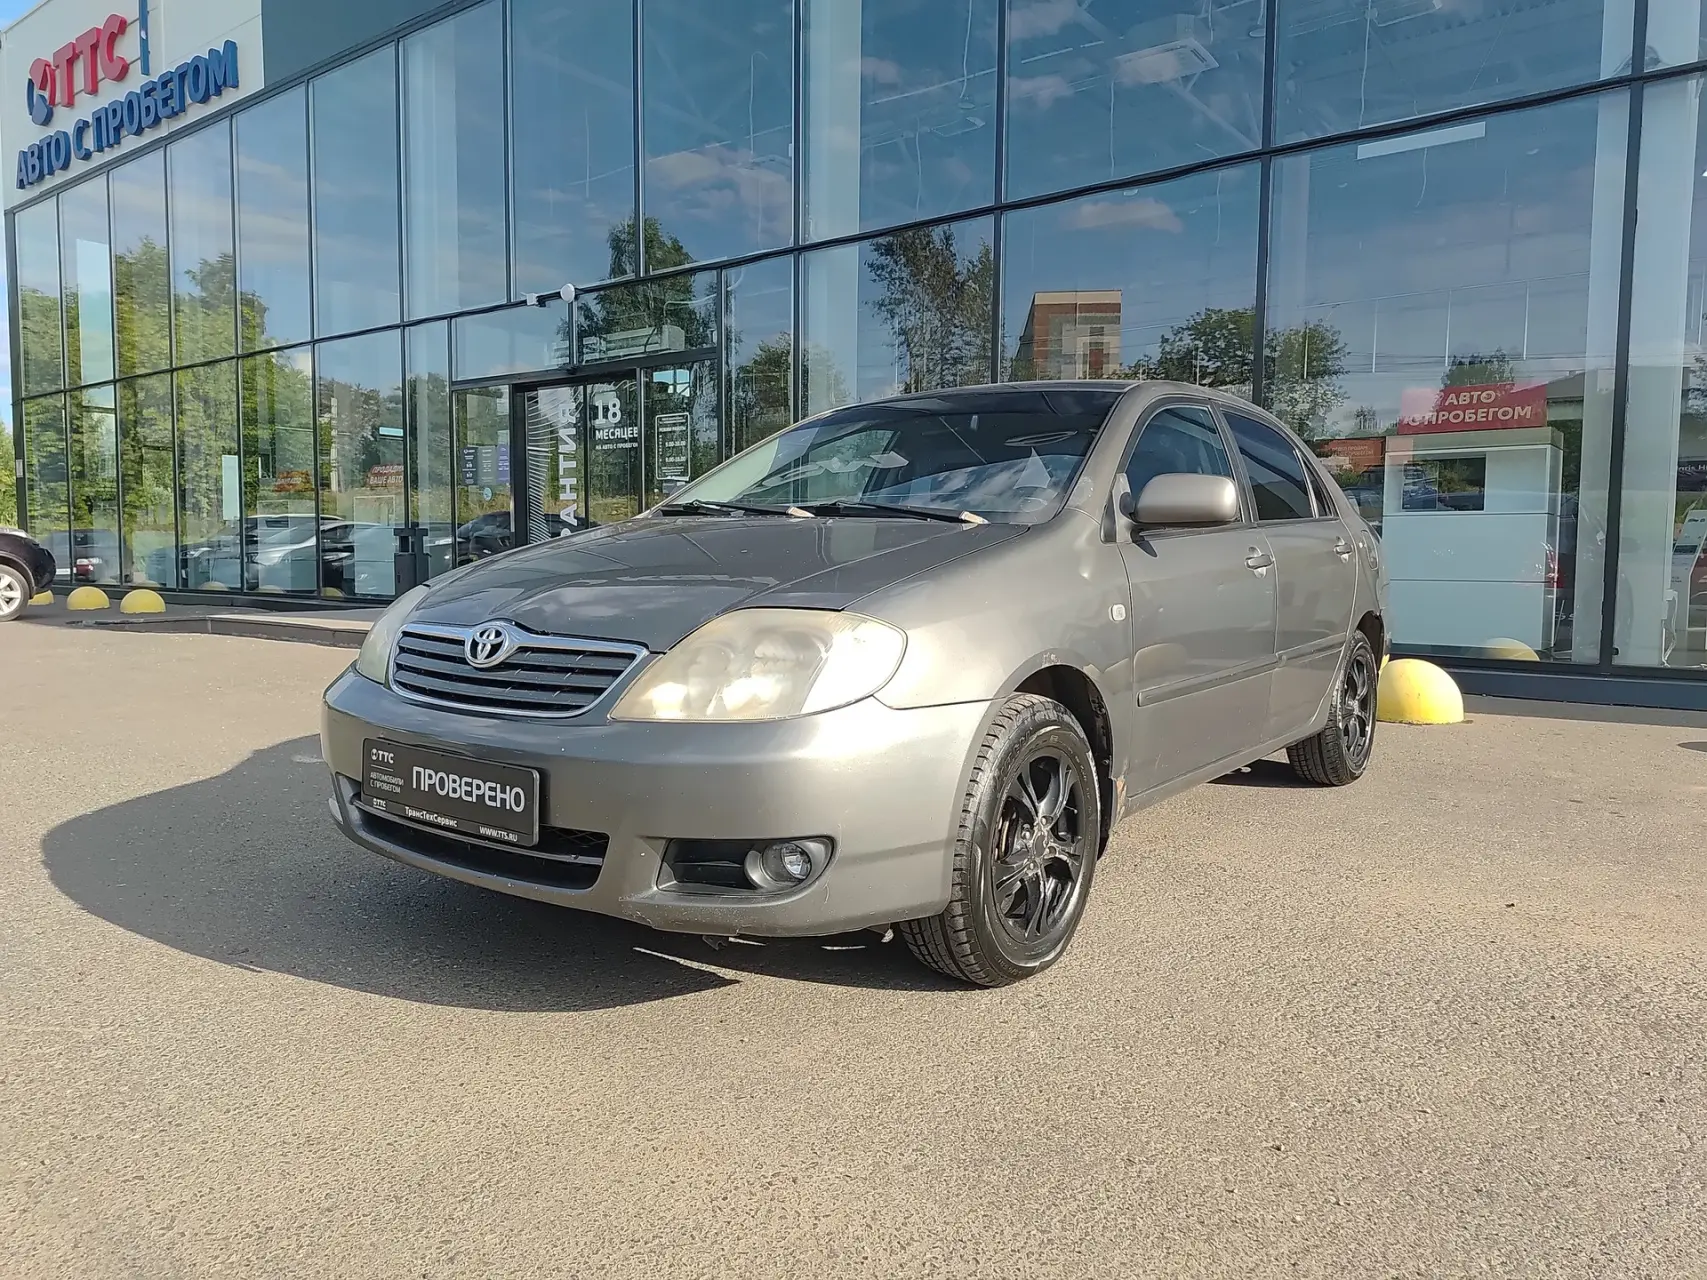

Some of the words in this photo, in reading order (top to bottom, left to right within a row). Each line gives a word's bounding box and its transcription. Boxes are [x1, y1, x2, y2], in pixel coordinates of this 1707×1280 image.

[16, 130, 71, 189] АВТО
[72, 118, 92, 161] С
[91, 39, 239, 153] ПРОБЕГОМ
[1445, 390, 1496, 406] АВТО
[595, 398, 622, 424] 18
[1424, 406, 1532, 425] ПРОБЕГОМ
[370, 771, 404, 786] АВТОМОБИЛИ
[370, 780, 375, 788] С
[375, 781, 402, 794] ПРОБЕГОМ
[412, 766, 526, 813] ПРОВЕРЕНО
[404, 806, 458, 828] ТрансТехСервис
[479, 826, 518, 842] WWW.TTS.RU
